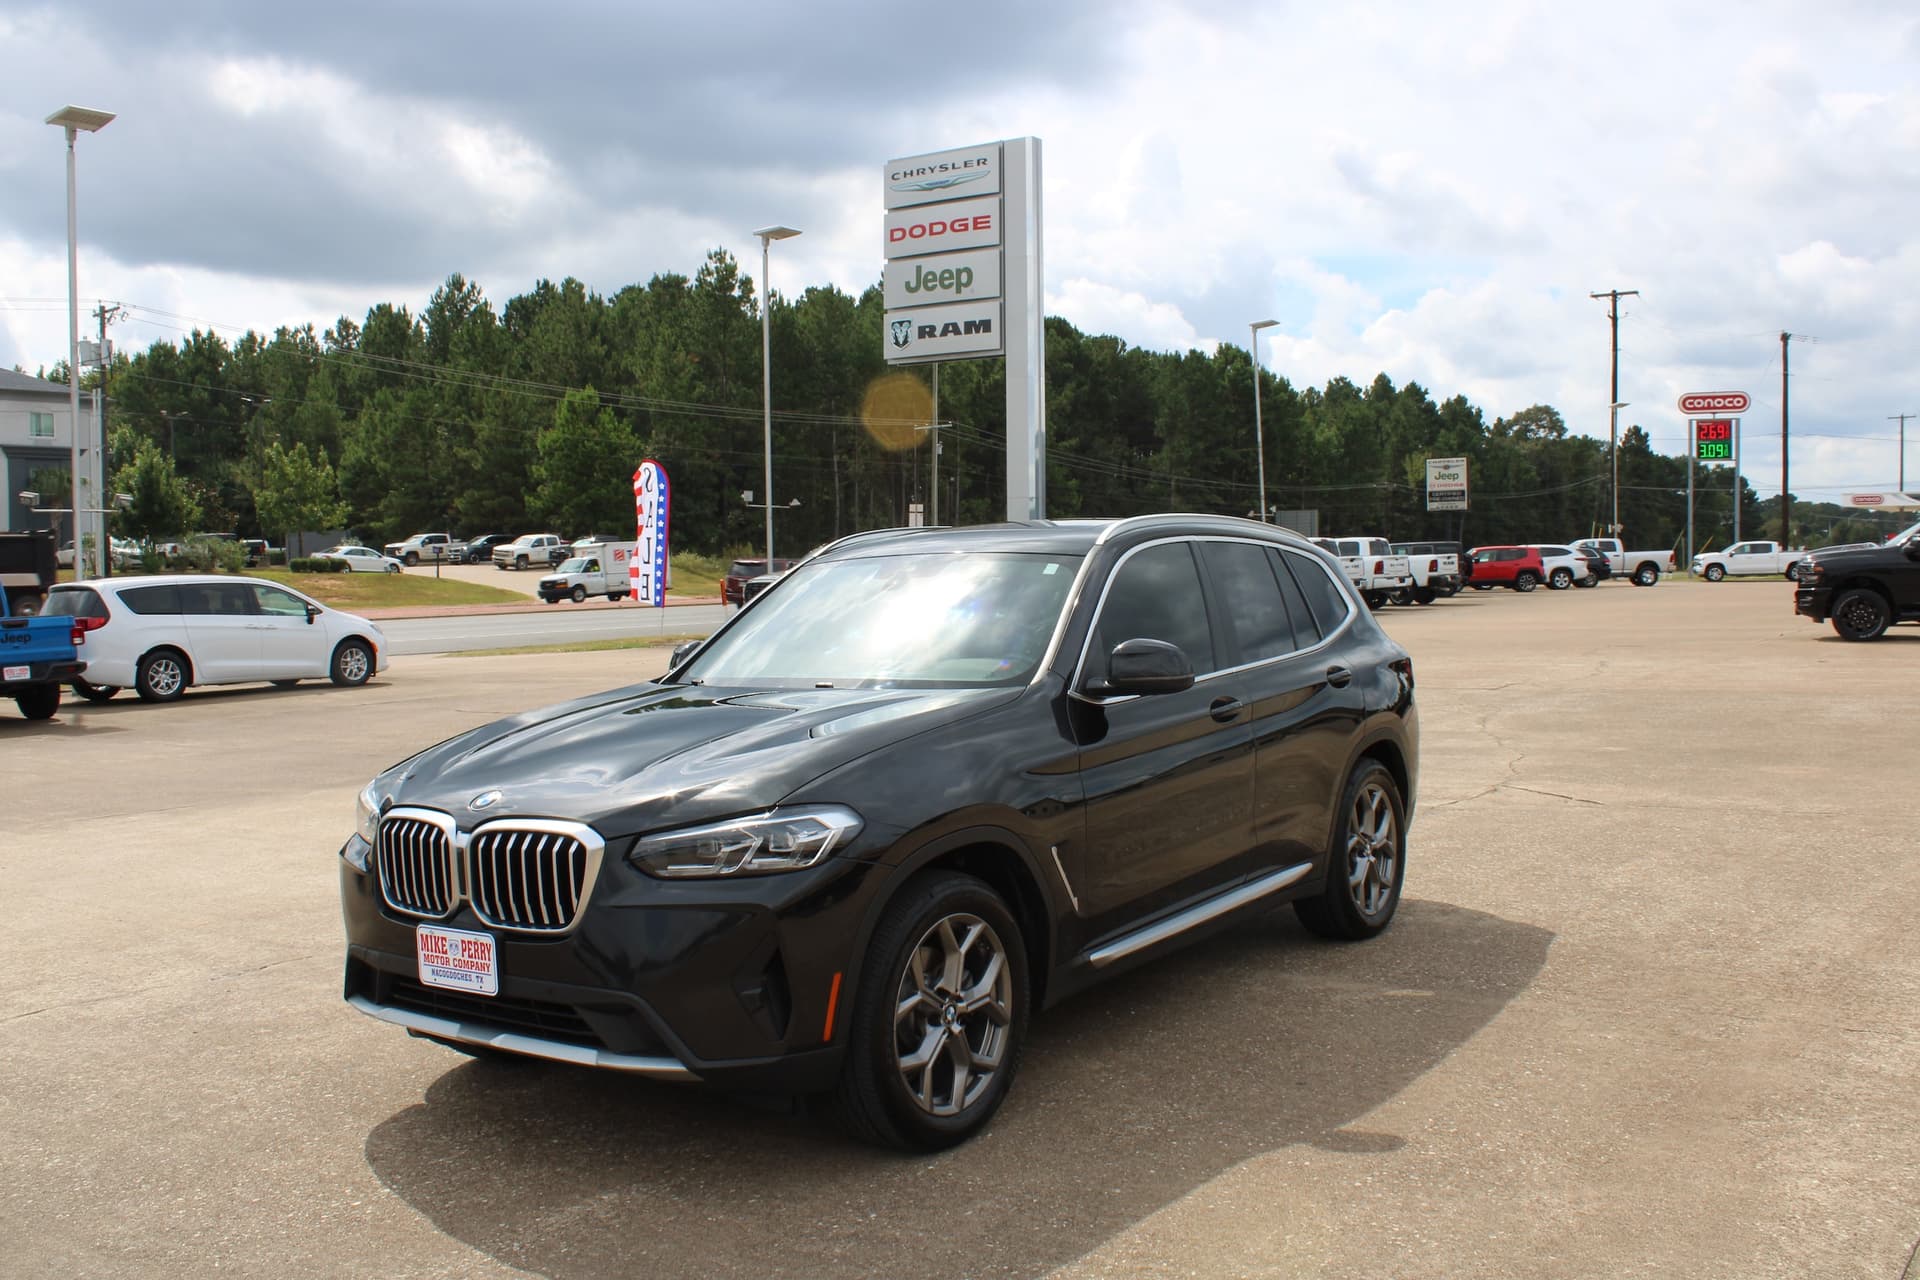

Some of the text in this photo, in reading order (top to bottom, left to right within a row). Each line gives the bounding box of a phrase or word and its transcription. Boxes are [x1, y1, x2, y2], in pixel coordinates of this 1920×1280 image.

[891, 157, 989, 181] CHRYSLER
[889, 215, 992, 242] DODGE
[904, 264, 974, 294] Jeep
[917, 319, 992, 340] RAM
[1434, 471, 1459, 481] Jeep
[0, 632, 31, 644] Jeep
[420, 934, 491, 961] MIKE PERRY
[423, 954, 491, 973] MOTOR COMPANY
[476, 975, 484, 984] TX
